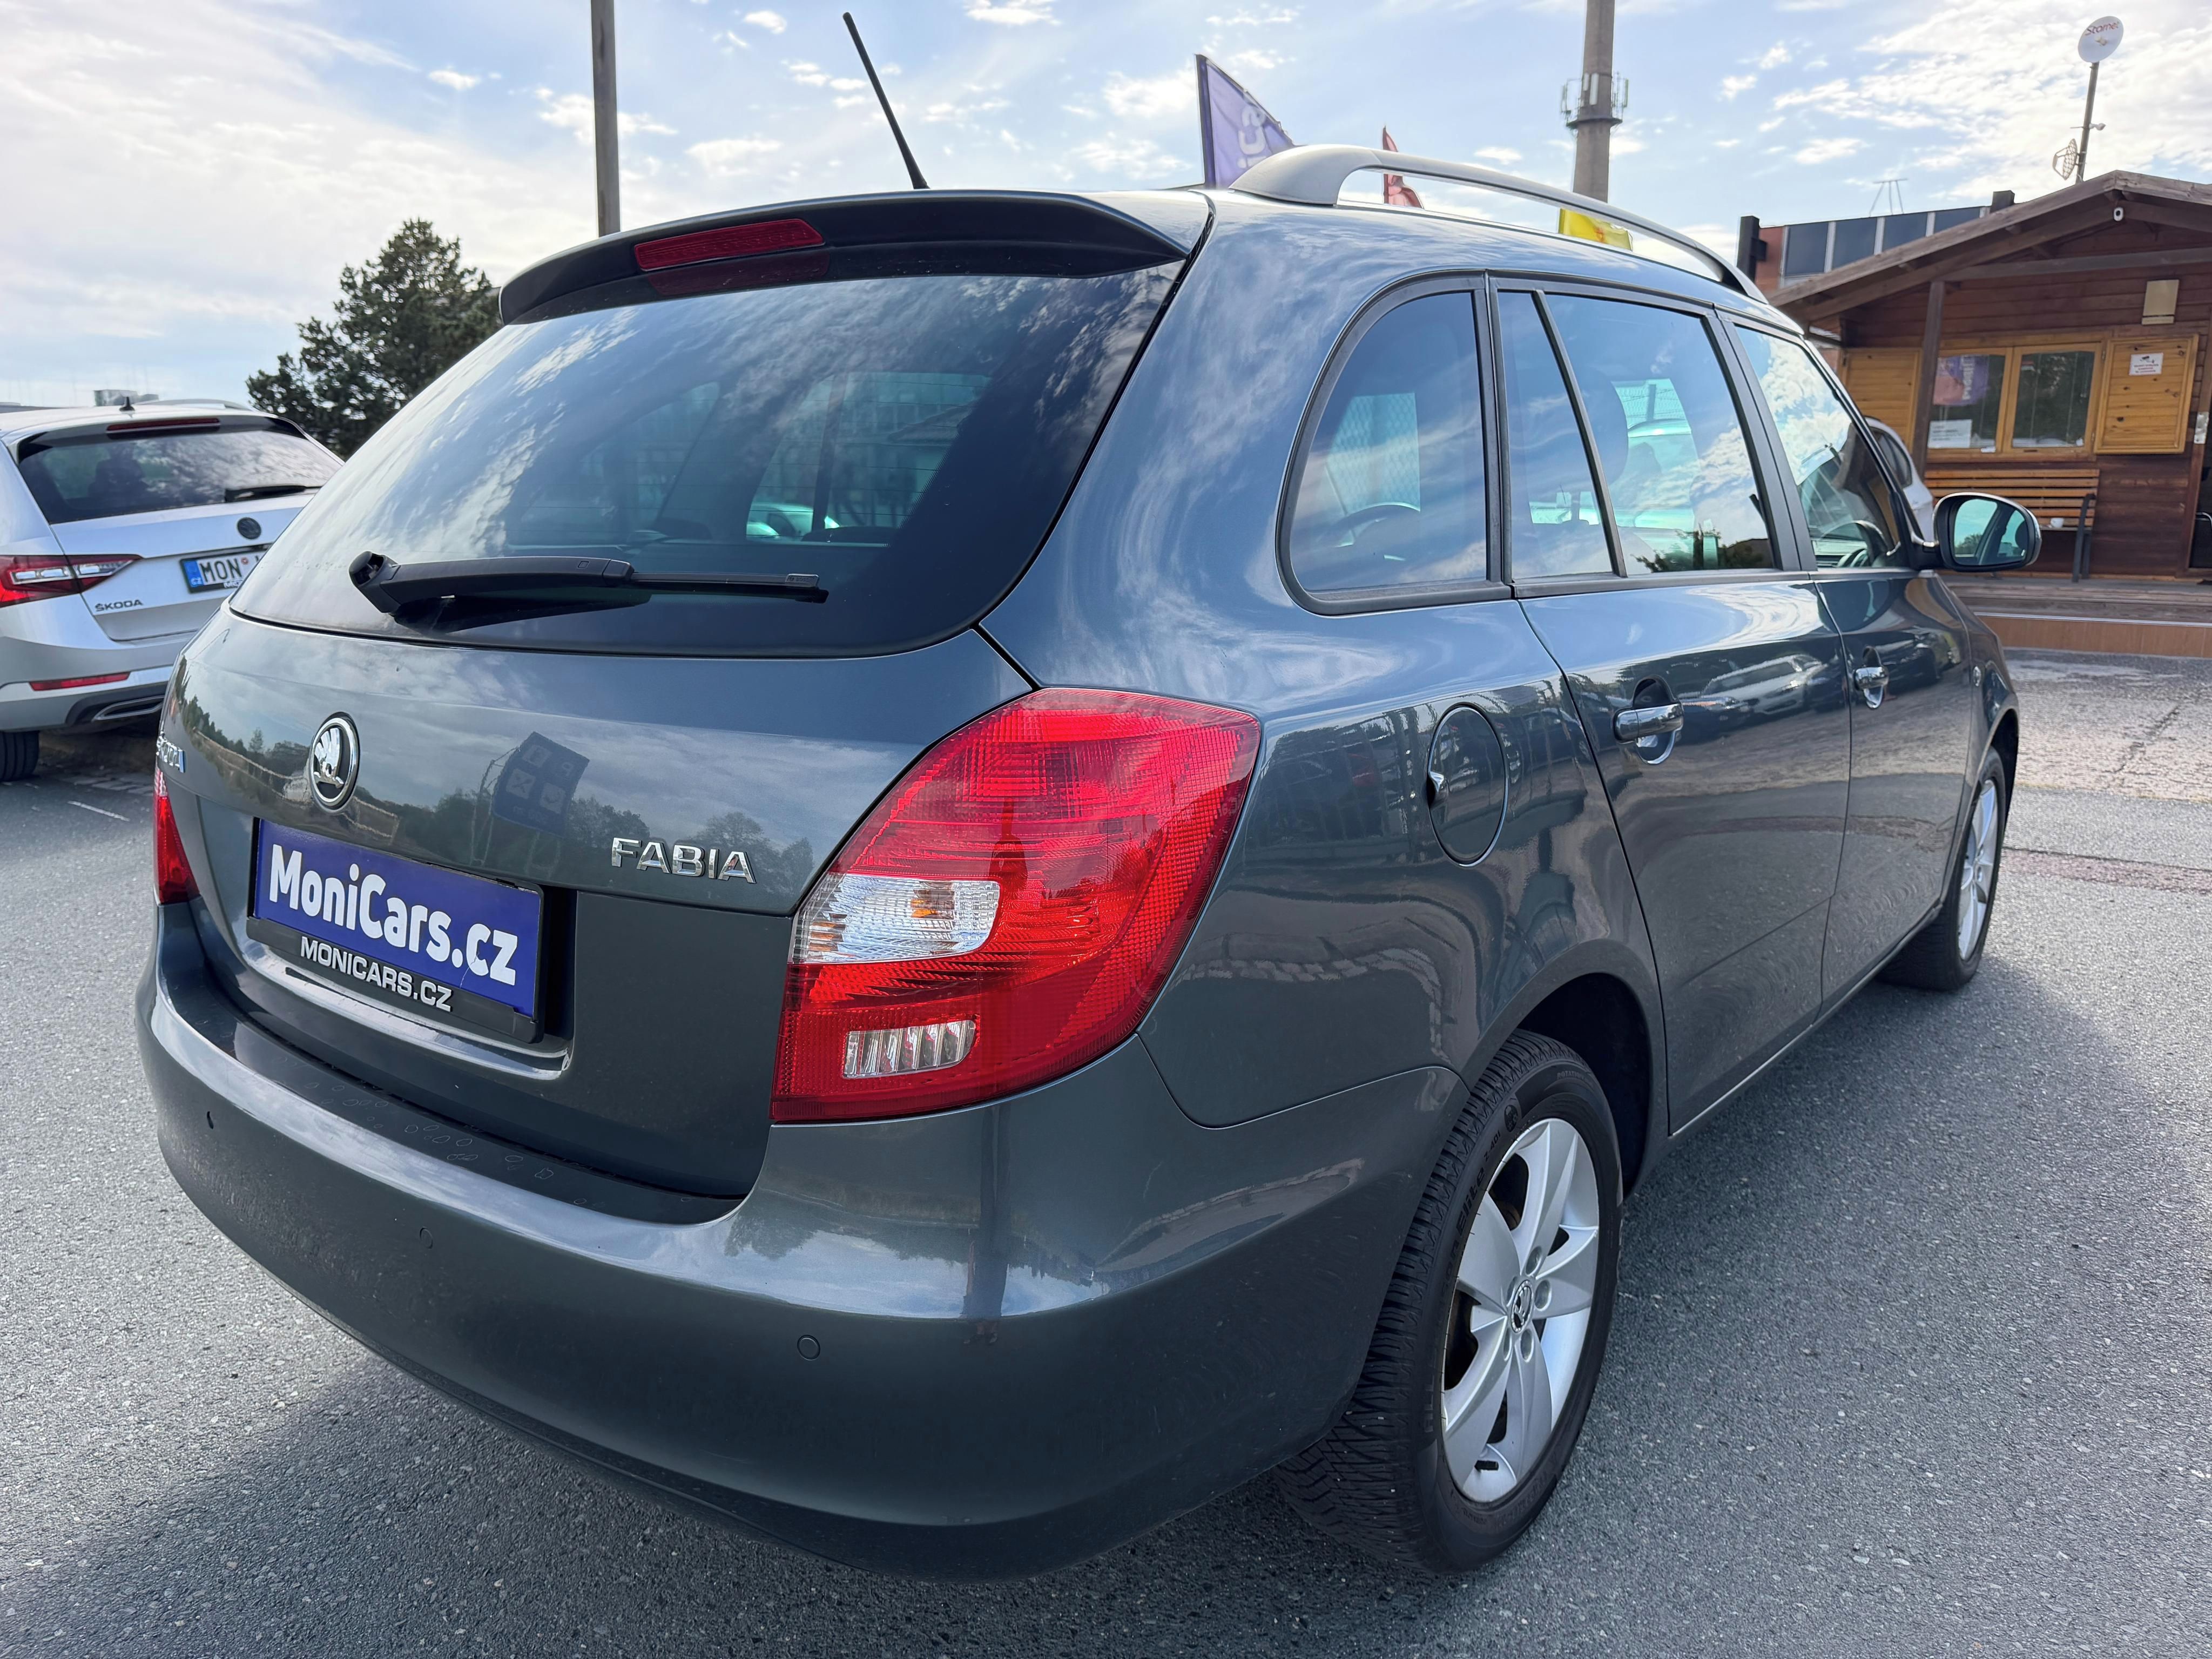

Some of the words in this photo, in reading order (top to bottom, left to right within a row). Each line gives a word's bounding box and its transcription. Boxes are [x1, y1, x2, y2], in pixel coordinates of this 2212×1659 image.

[199, 558, 242, 583] MON
[611, 837, 757, 884] FABIA
[269, 844, 518, 986] MoniCars.cz
[300, 936, 453, 1013] MONICARS.CZ
